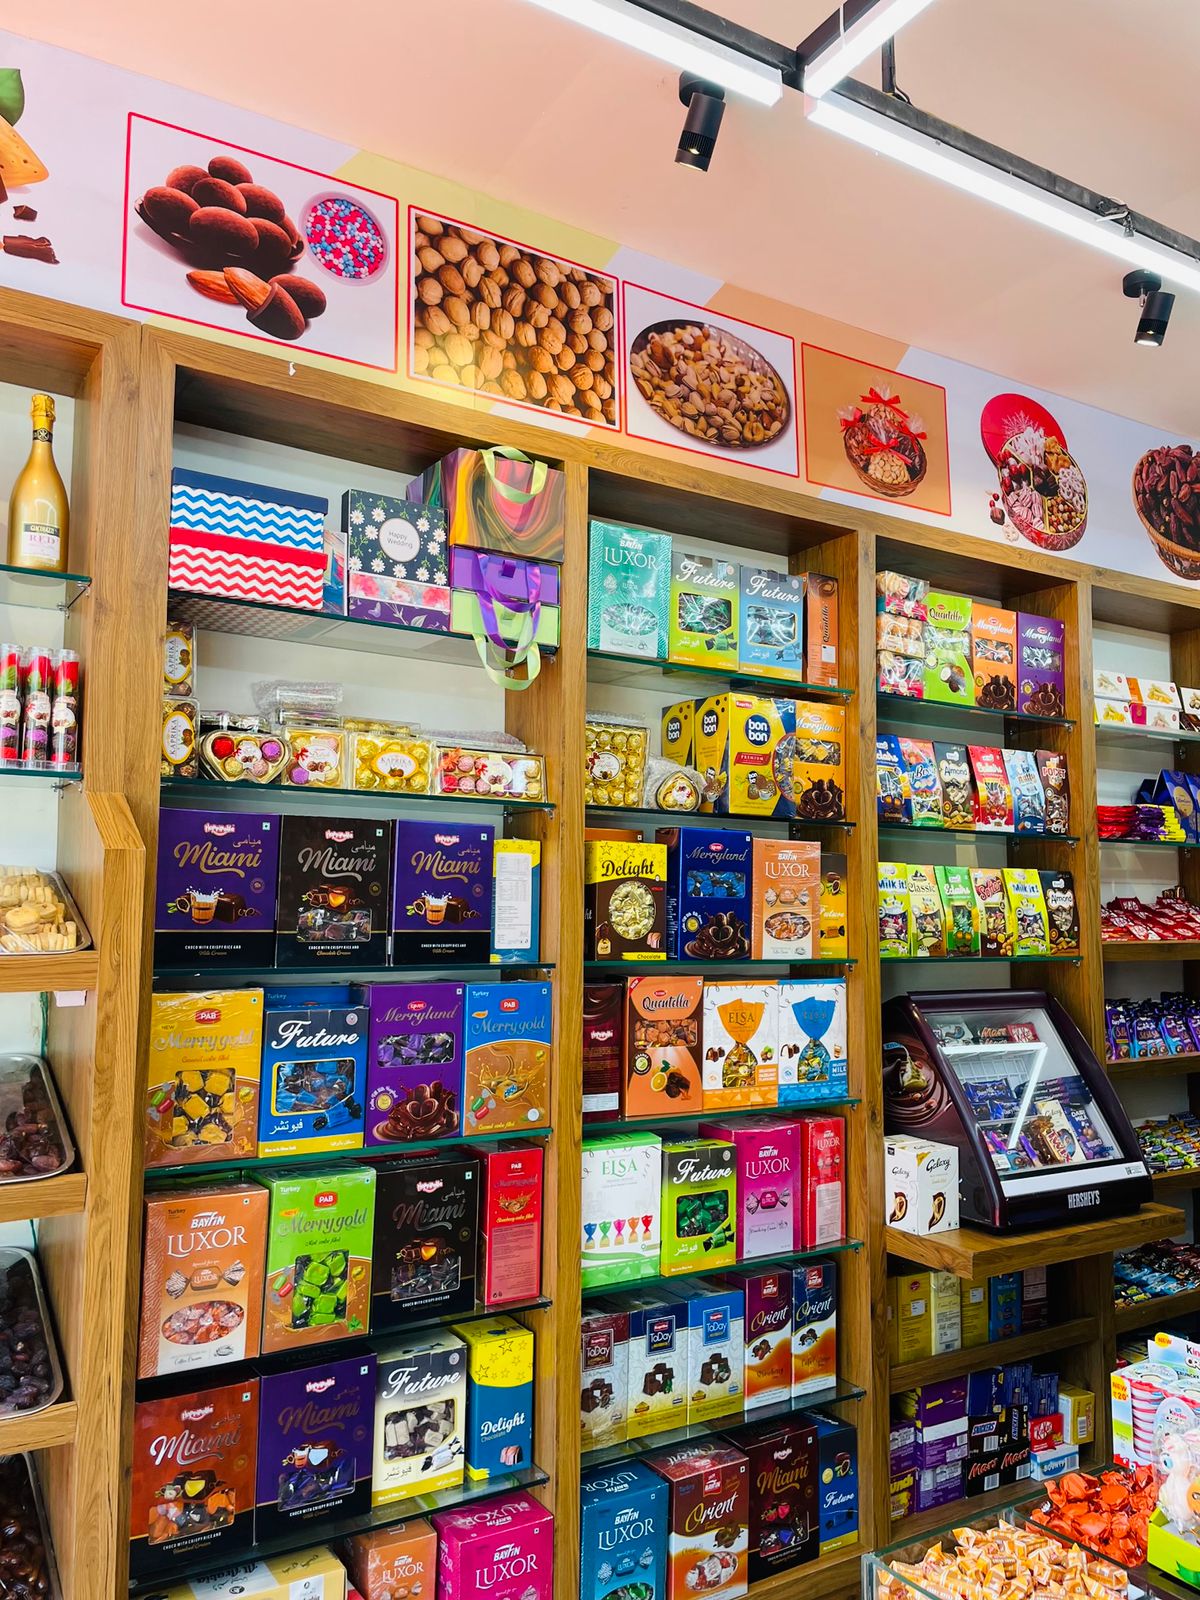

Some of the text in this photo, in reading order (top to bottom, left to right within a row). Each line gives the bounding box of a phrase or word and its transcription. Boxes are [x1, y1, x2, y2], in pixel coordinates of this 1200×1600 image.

[387, 538, 413, 549] Wedding
[604, 546, 659, 570] LUXOR
[676, 558, 735, 590] Future
[745, 575, 801, 603] Future
[167, 640, 176, 675] KAPRIKA
[667, 721, 680, 731] bon
[704, 714, 717, 724] bon
[704, 724, 717, 733] bon
[749, 718, 768, 731] bon
[169, 719, 177, 755] KAPRIKA
[667, 730, 680, 739] bon
[749, 730, 768, 742] bon
[944, 764, 968, 776] Almond
[174, 841, 262, 878] Miami
[298, 847, 377, 882] Miami
[411, 850, 481, 883] Miami
[685, 846, 750, 865] Merryland
[601, 858, 655, 878] Delight
[765, 862, 810, 879] LUXOR
[1051, 893, 1073, 904] Almond
[375, 1005, 460, 1027] Merryland
[728, 1011, 755, 1026] ELSA
[271, 1019, 360, 1049] Future
[602, 1158, 638, 1178] ELSA
[673, 1158, 733, 1185] Future
[745, 1156, 791, 1179] LUXOR
[925, 1157, 952, 1174] Galaxy
[319, 1195, 333, 1203] PAB
[1067, 1190, 1100, 1209] HERSHEY'S
[393, 1199, 466, 1232] Miami
[167, 1225, 248, 1258] LUXOR
[750, 1305, 789, 1332] Orient
[649, 1332, 673, 1344] ToDay
[586, 1345, 610, 1357] ToDay
[382, 1366, 461, 1399] Future
[278, 1396, 360, 1435] Miami
[480, 1412, 525, 1438] Delight
[149, 1425, 241, 1466] Miami
[968, 1457, 998, 1480] Mars
[1001, 1447, 1030, 1470] Mars
[580, 1471, 639, 1493] LUXOR
[757, 1460, 810, 1495] Miami
[823, 1490, 855, 1509] Future
[685, 1491, 739, 1533] Orient
[597, 1518, 655, 1551] LUXOR
[382, 1562, 425, 1583] LUXOR
[475, 1553, 538, 1590] LUXOR
